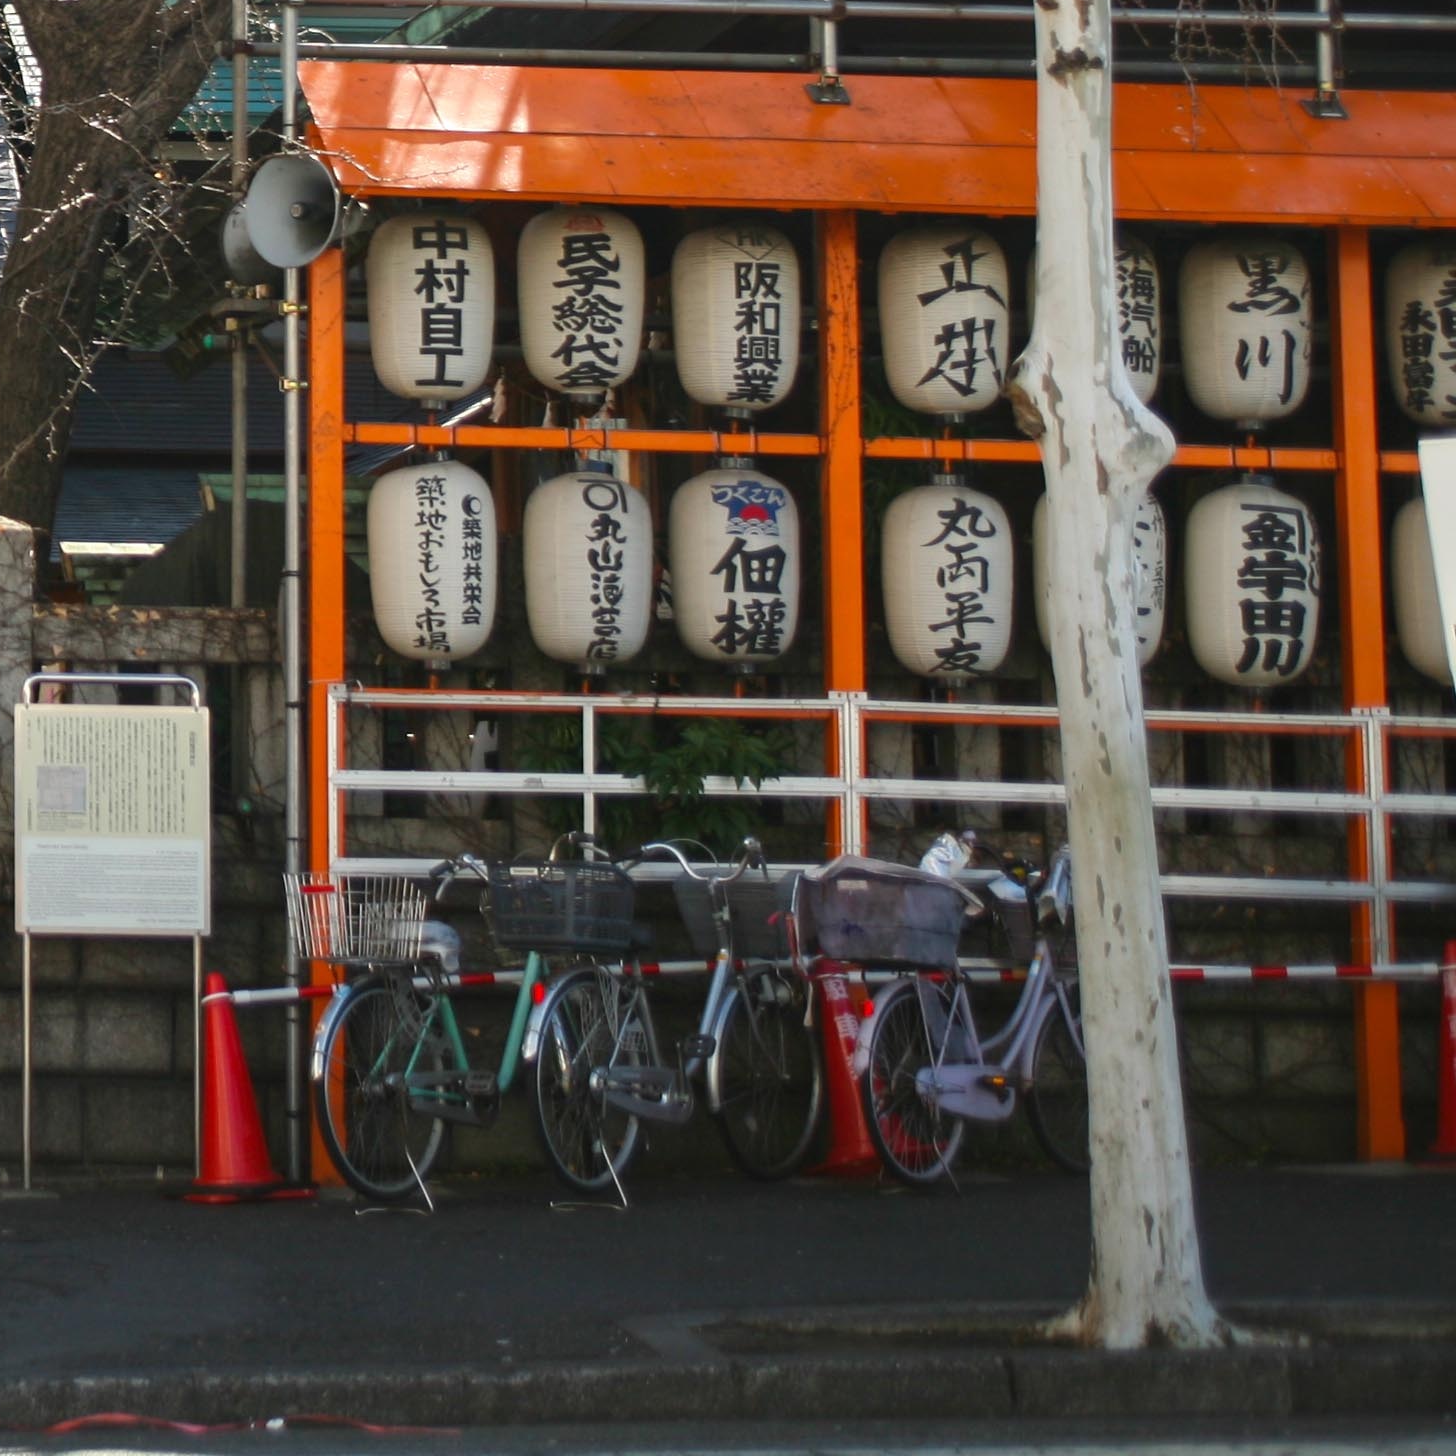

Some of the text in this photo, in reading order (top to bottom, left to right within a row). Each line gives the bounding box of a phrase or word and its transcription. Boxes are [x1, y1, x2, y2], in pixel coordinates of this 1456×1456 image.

[412, 220, 470, 387] 中村自工
[551, 233, 625, 388] 氏子総代会
[728, 262, 782, 404] 阪和興業
[1226, 253, 1301, 406] 黒川
[413, 476, 452, 653] 築地おもしろ市場
[711, 485, 786, 507] つくごん
[461, 518, 483, 626] 築地共栄会
[585, 514, 628, 661] 丸山海苔店
